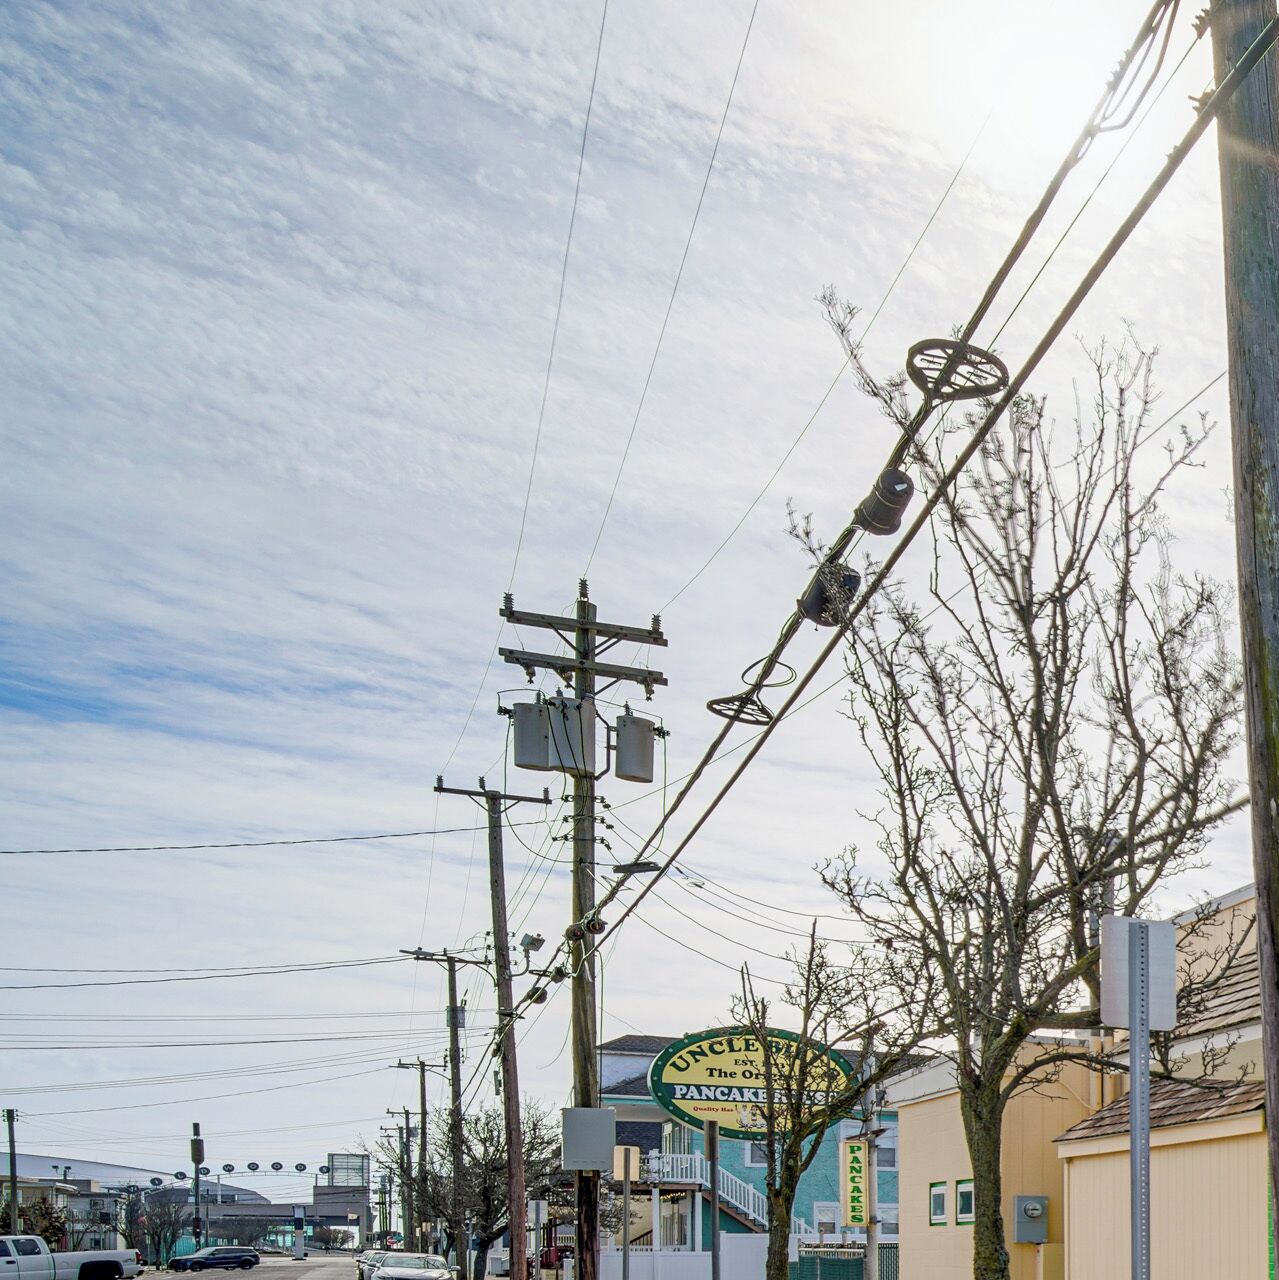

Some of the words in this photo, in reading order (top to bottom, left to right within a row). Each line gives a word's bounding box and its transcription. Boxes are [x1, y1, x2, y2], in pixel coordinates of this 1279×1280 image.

[669, 1037, 759, 1073] UNCLE
[705, 1067, 737, 1079] The
[673, 1085, 767, 1102] PANCAKE
[848, 1145, 865, 1224] PANCAKES
